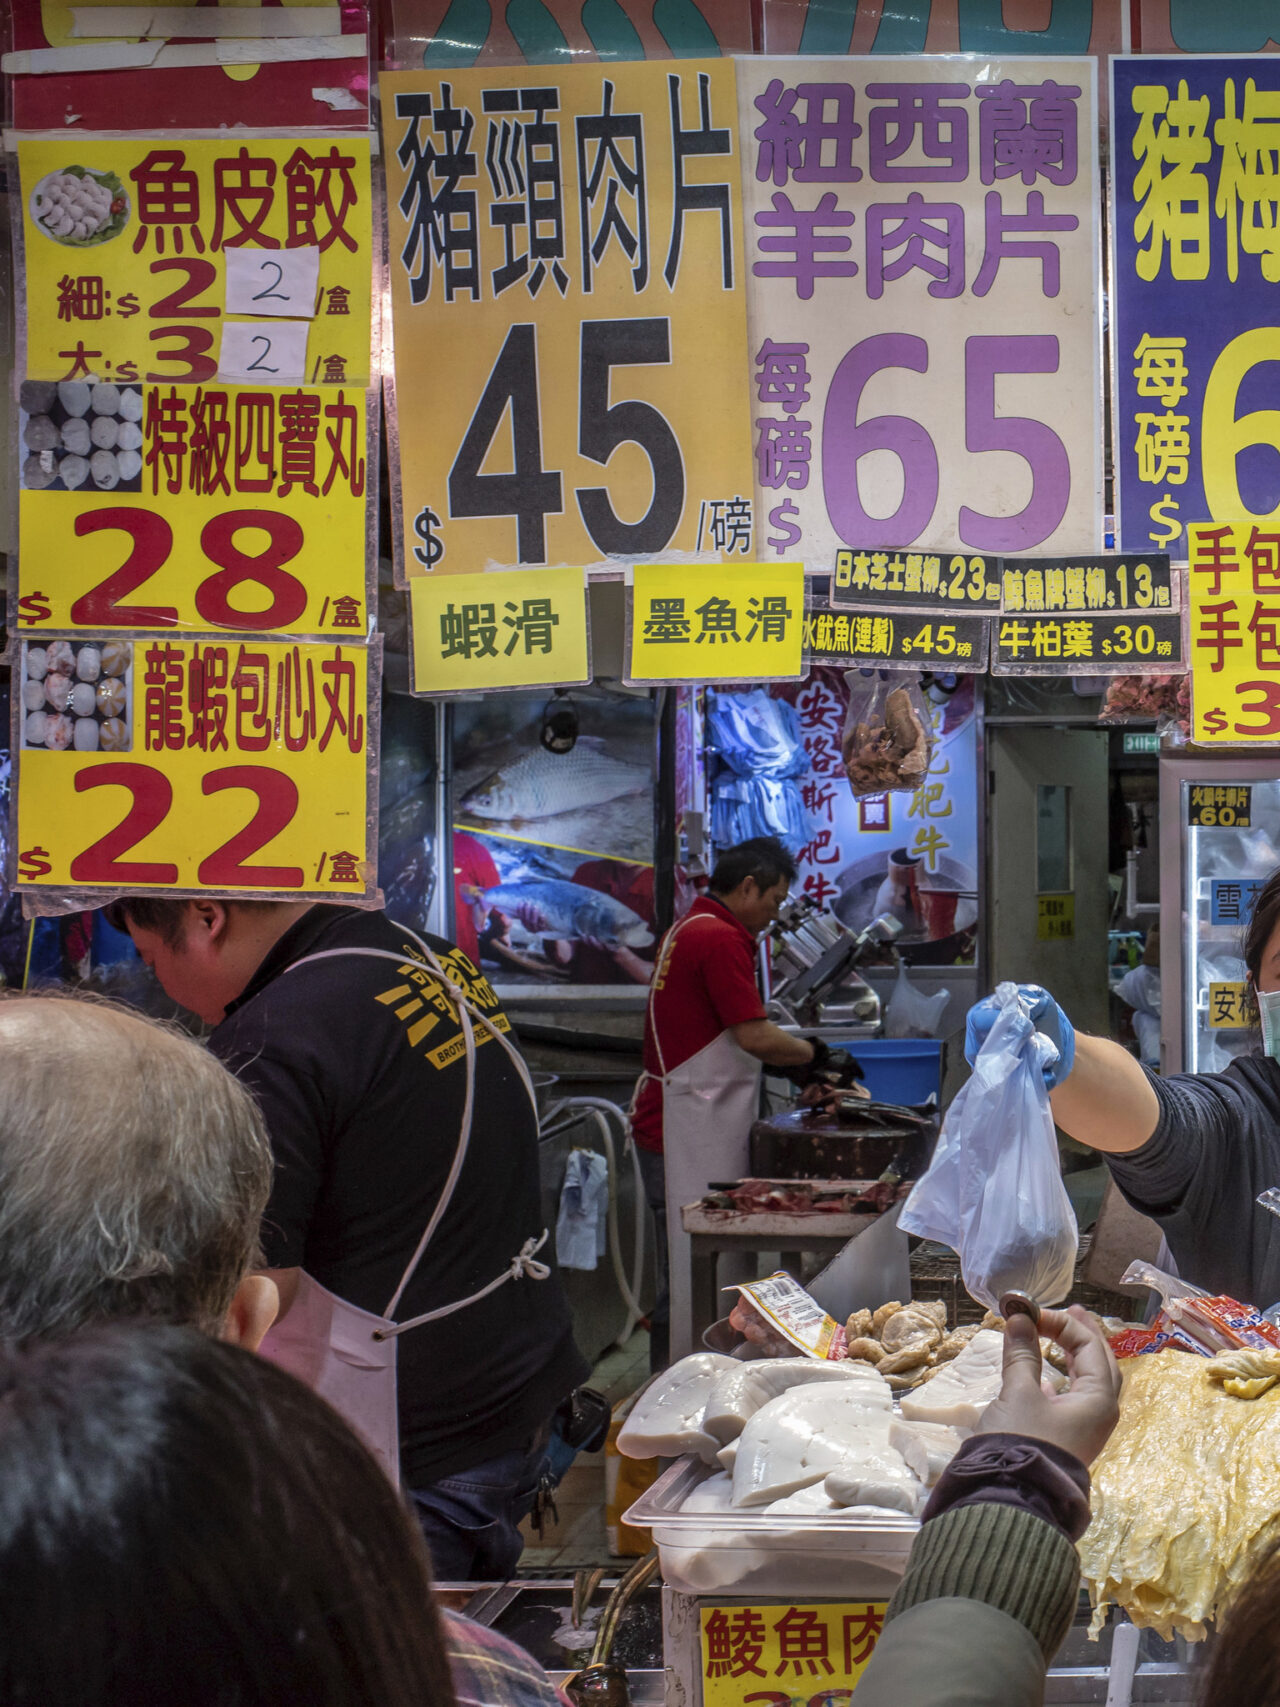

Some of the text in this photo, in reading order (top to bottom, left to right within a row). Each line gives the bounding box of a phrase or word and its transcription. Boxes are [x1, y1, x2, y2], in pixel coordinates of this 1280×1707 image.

[753, 78, 1081, 188] 紐西蘭
[130, 146, 359, 256] 魚皮餃
[395, 73, 734, 305] 豬頸肉片
[752, 192, 1079, 300] 羊肉片
[145, 386, 365, 498] 特級四寶丸
[822, 332, 1071, 553] 65
[440, 598, 559, 660] 蝦滑
[643, 595, 792, 645] 墨魚滑
[1000, 620, 1093, 657] 牛柏葉
[144, 641, 363, 755] 龍蝦包心丸
[705, 1605, 886, 1678] 鯪魚肉
